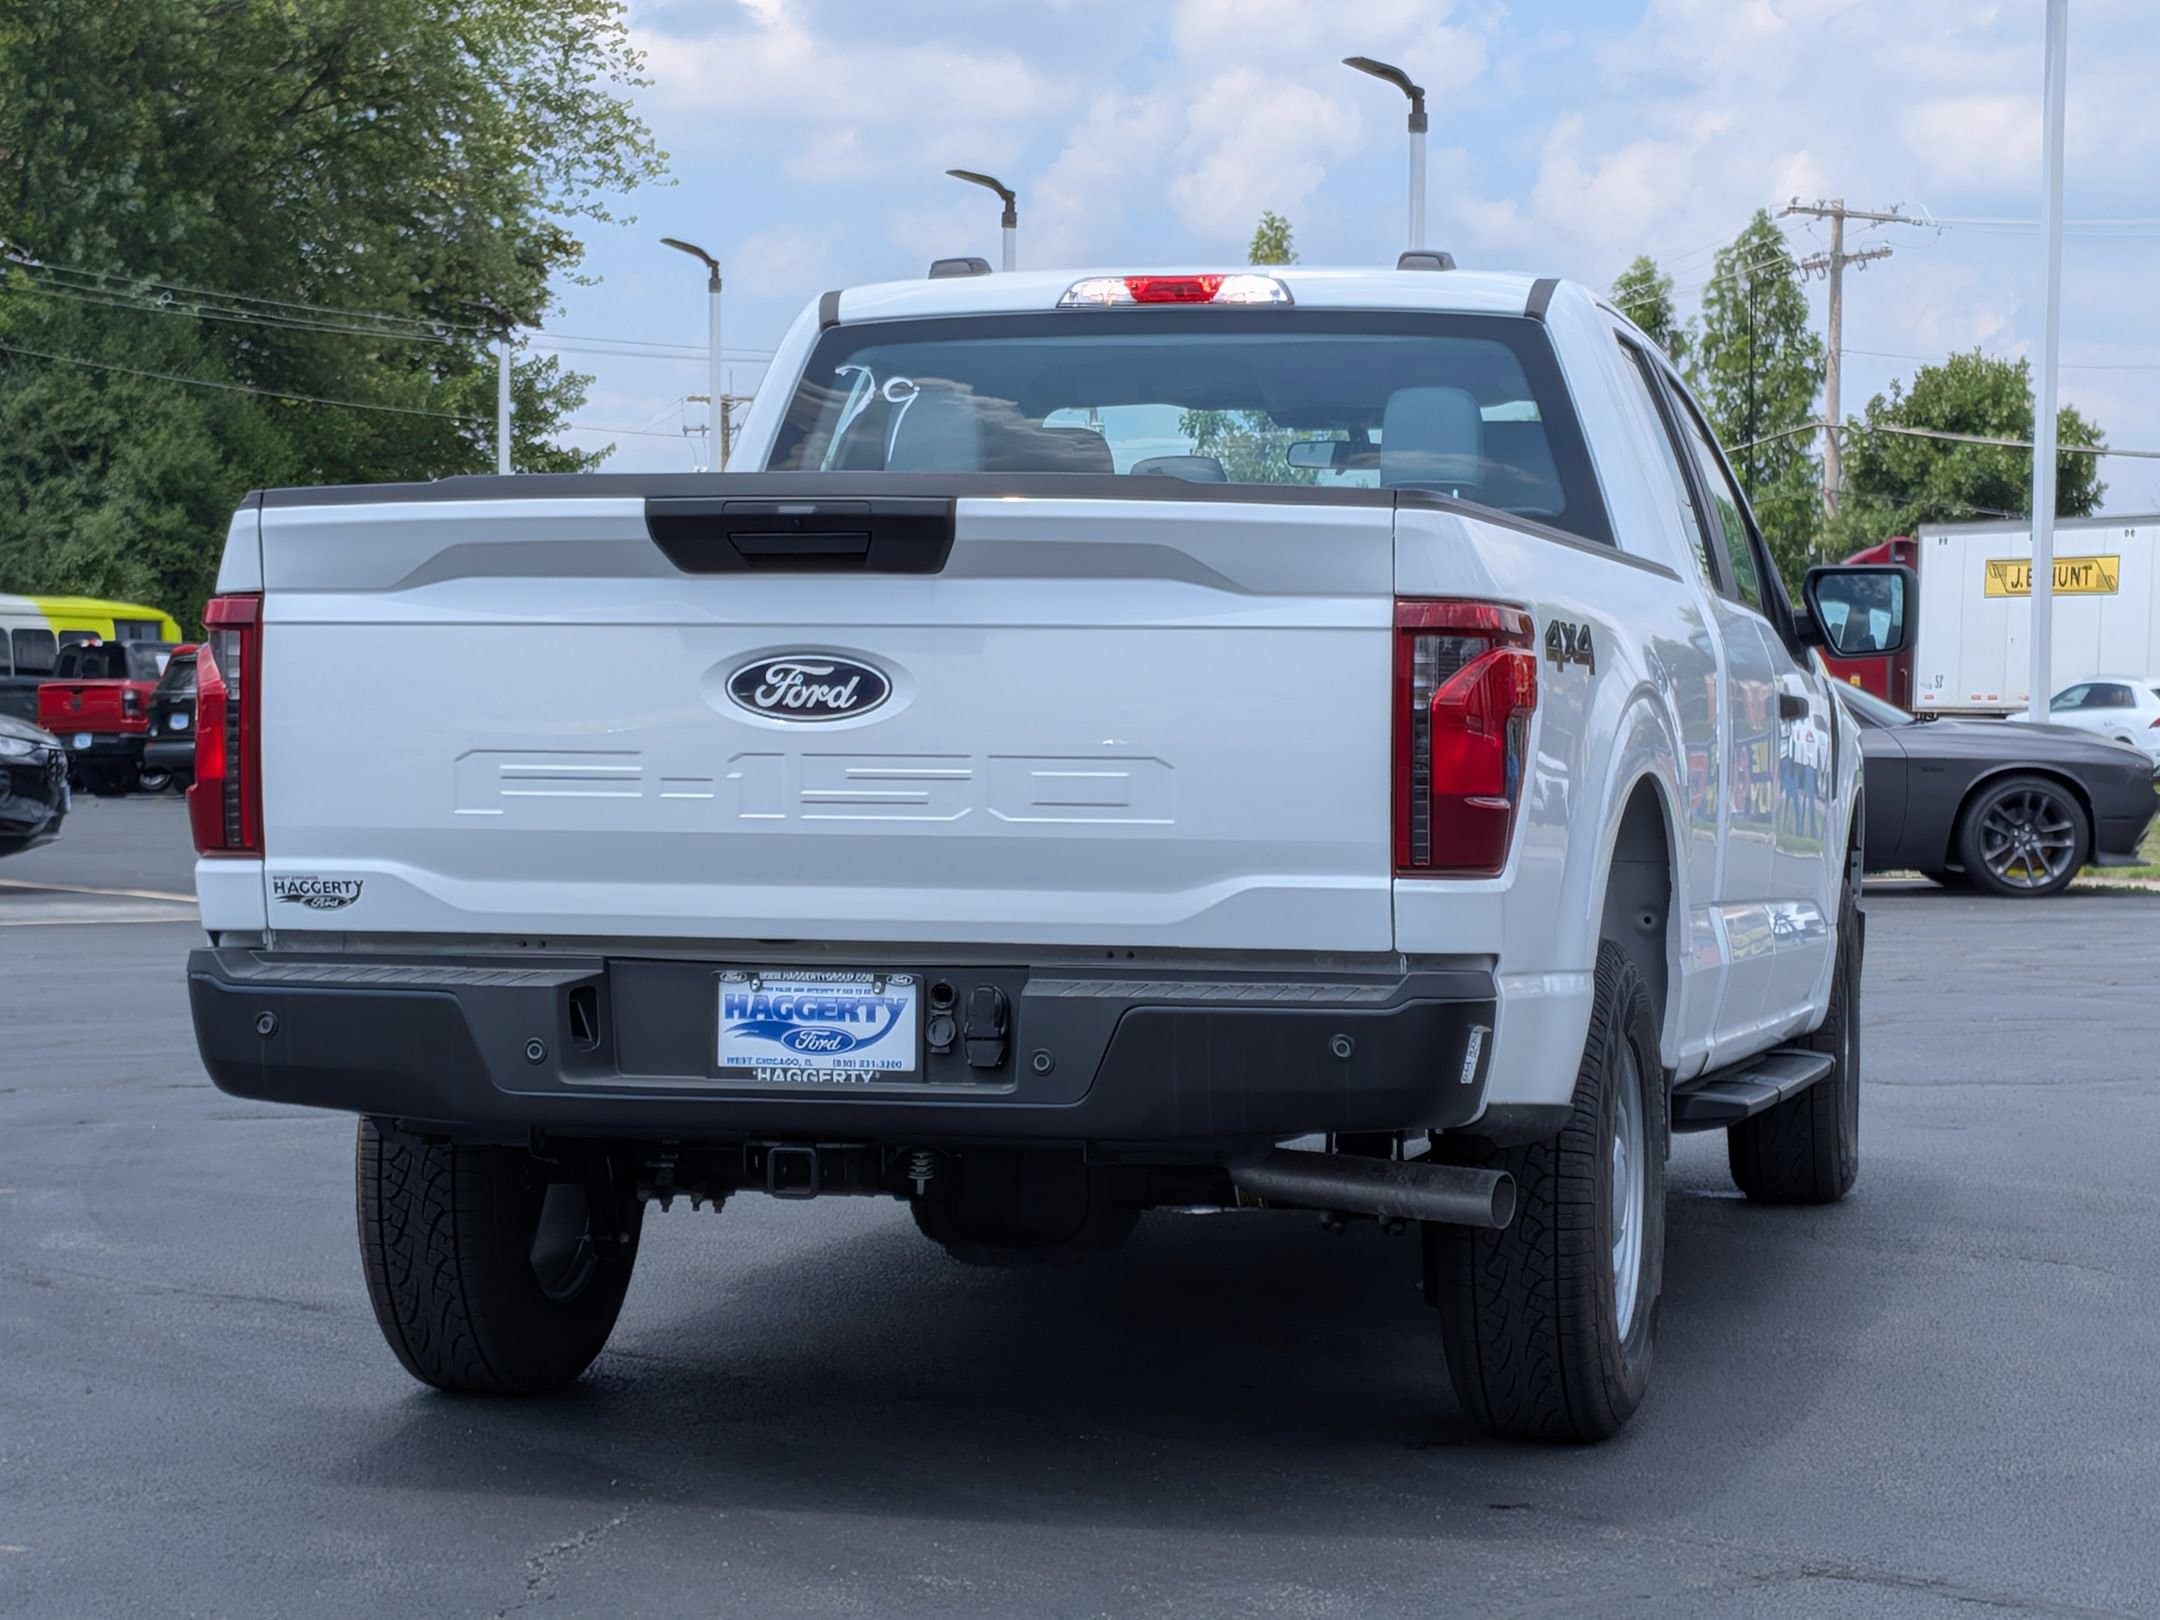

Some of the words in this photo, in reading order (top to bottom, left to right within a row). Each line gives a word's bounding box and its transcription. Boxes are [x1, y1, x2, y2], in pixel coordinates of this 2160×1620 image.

[754, 663, 861, 709] Ford
[454, 749, 1177, 824] F-150
[273, 879, 364, 895] HAGGERTY
[724, 993, 909, 1024] HAGGERTY
[794, 1030, 841, 1051] Ford
[756, 1068, 874, 1084] HAGGERTY
